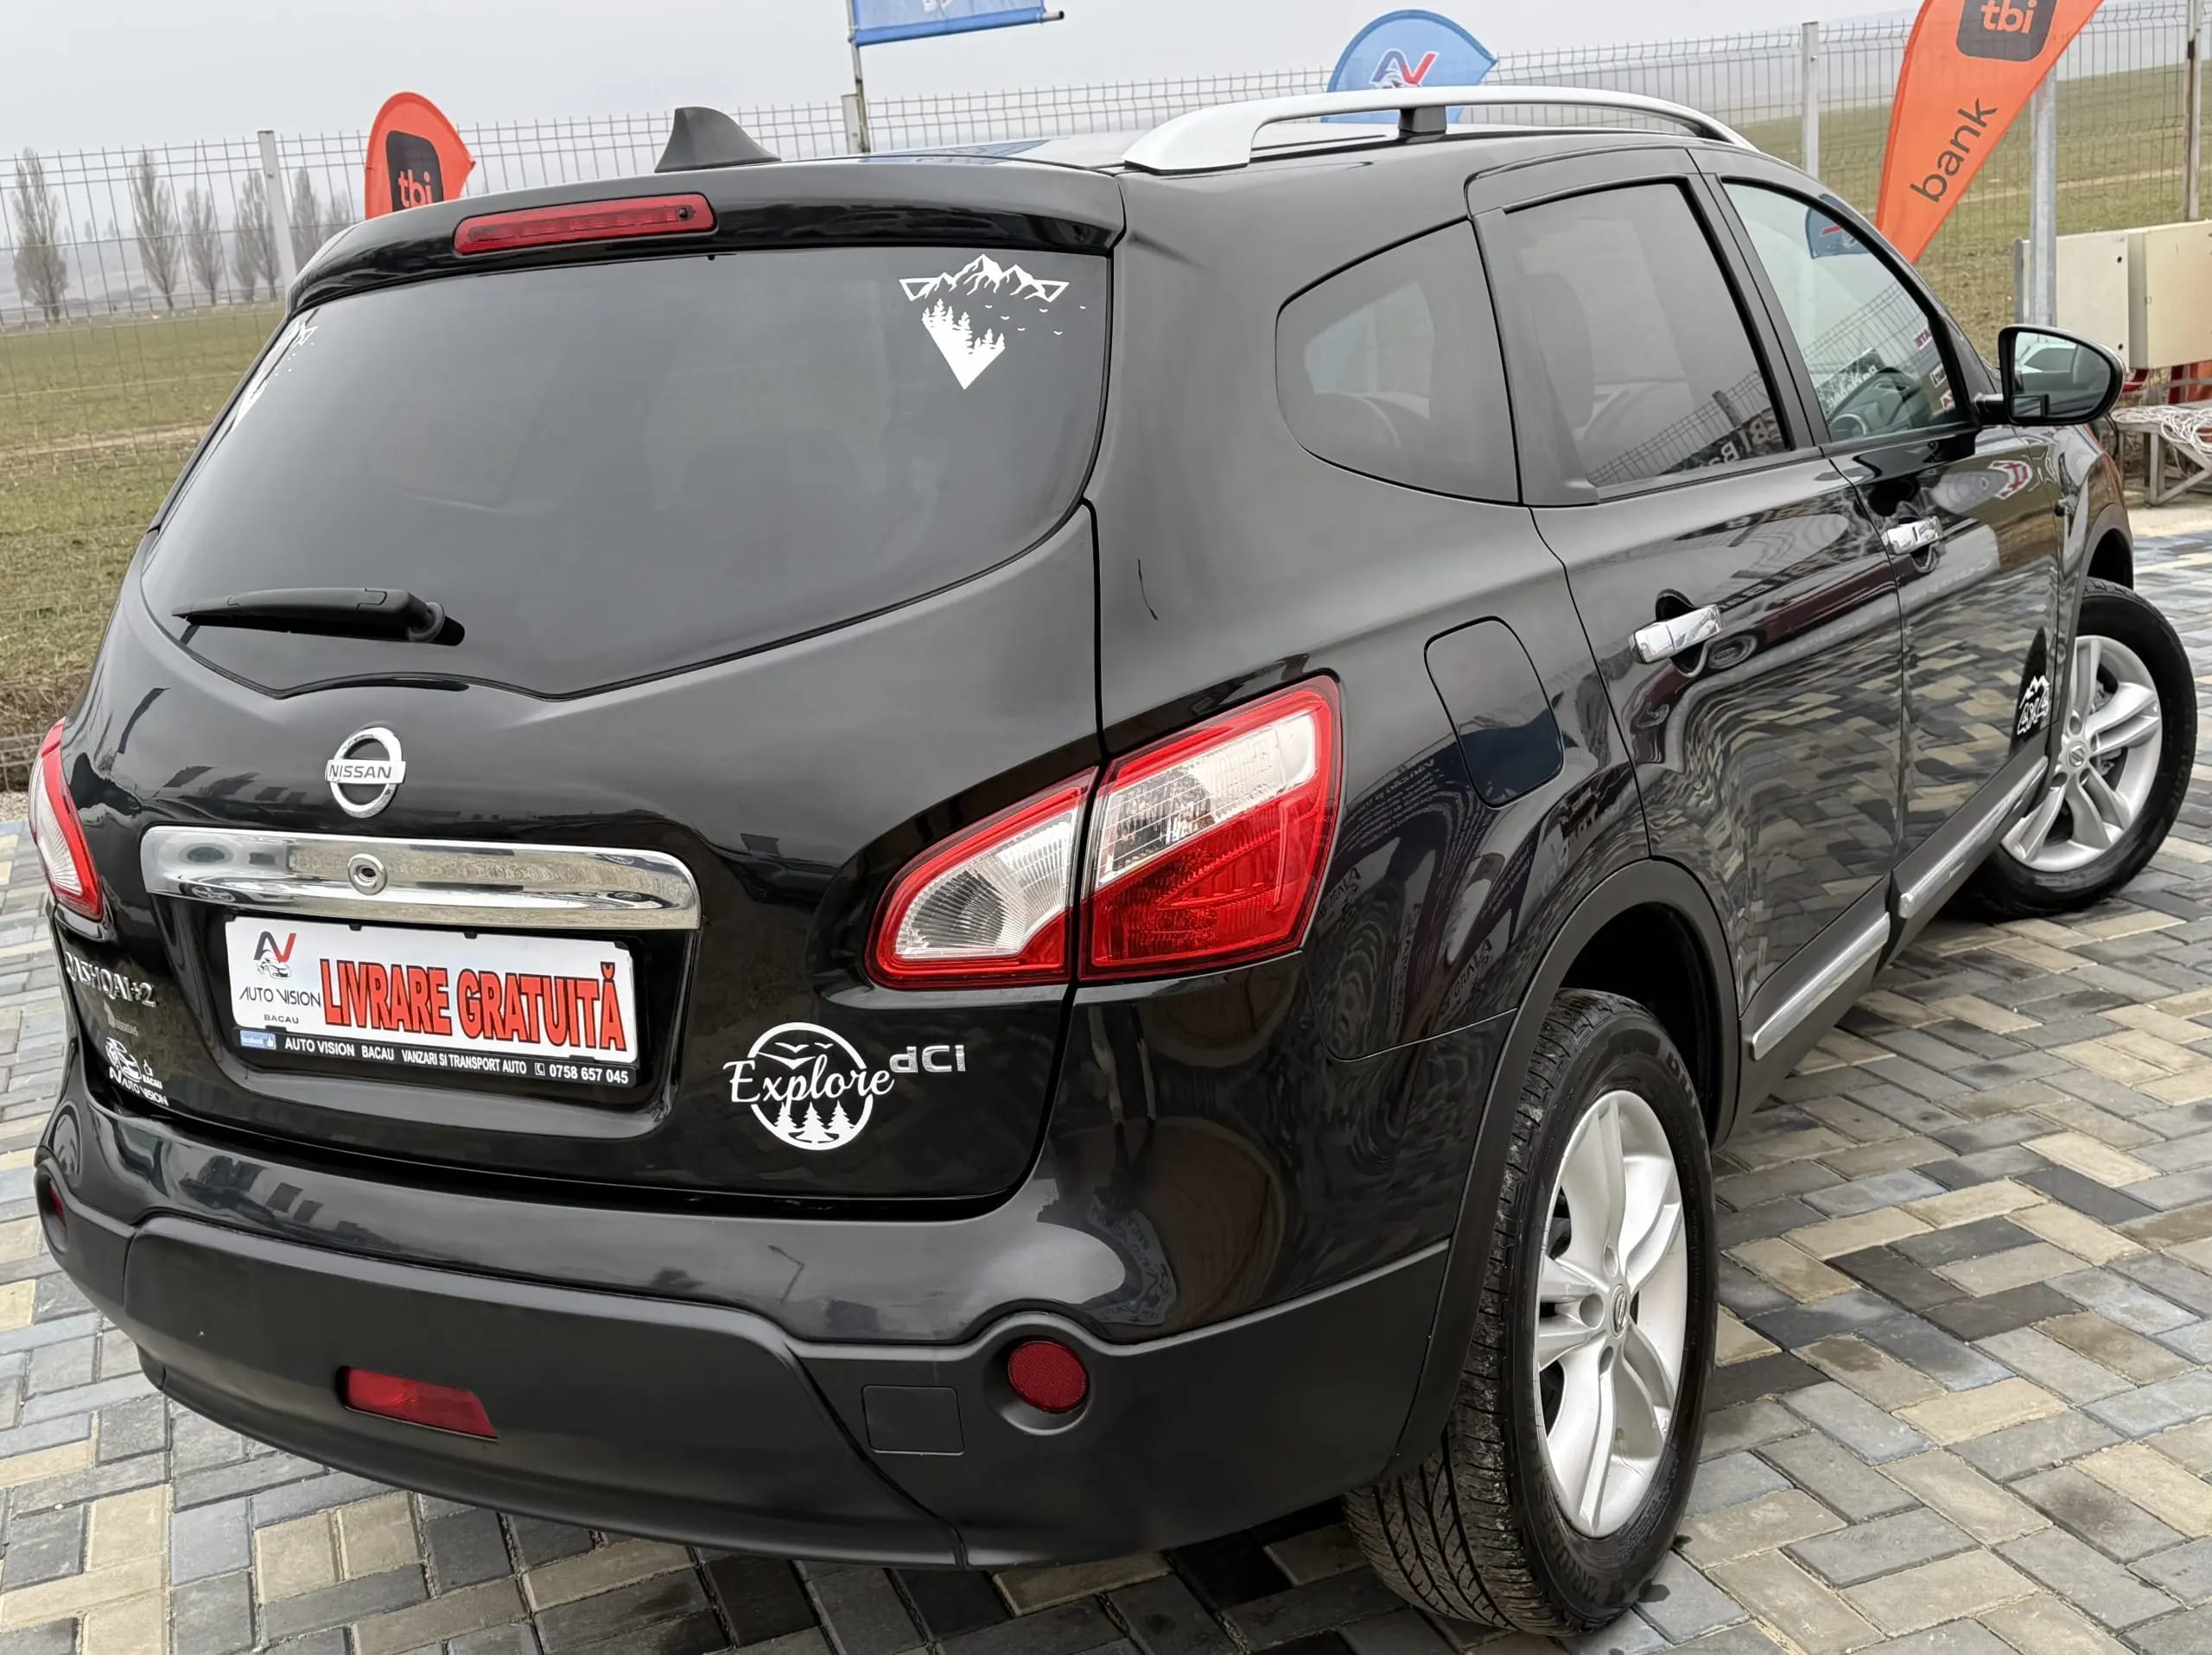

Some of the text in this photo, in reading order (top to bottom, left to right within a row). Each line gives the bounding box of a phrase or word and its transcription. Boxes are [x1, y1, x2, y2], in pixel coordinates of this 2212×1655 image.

[1980, 0, 2037, 34] tbi
[1910, 97, 1998, 202] bank
[398, 169, 432, 208] tbi
[329, 764, 391, 779] NISSAN
[239, 986, 321, 1008] AUTO VISION
[319, 958, 627, 1052] LIVRARE GRATUITĂ
[264, 1014, 300, 1024] BACAU
[284, 1037, 629, 1084] AUTO VISION BACAU VANZARI SI TRANSPORT AUTO 0758 657 045
[889, 1044, 966, 1073] dCi
[722, 1053, 895, 1115] Explore
